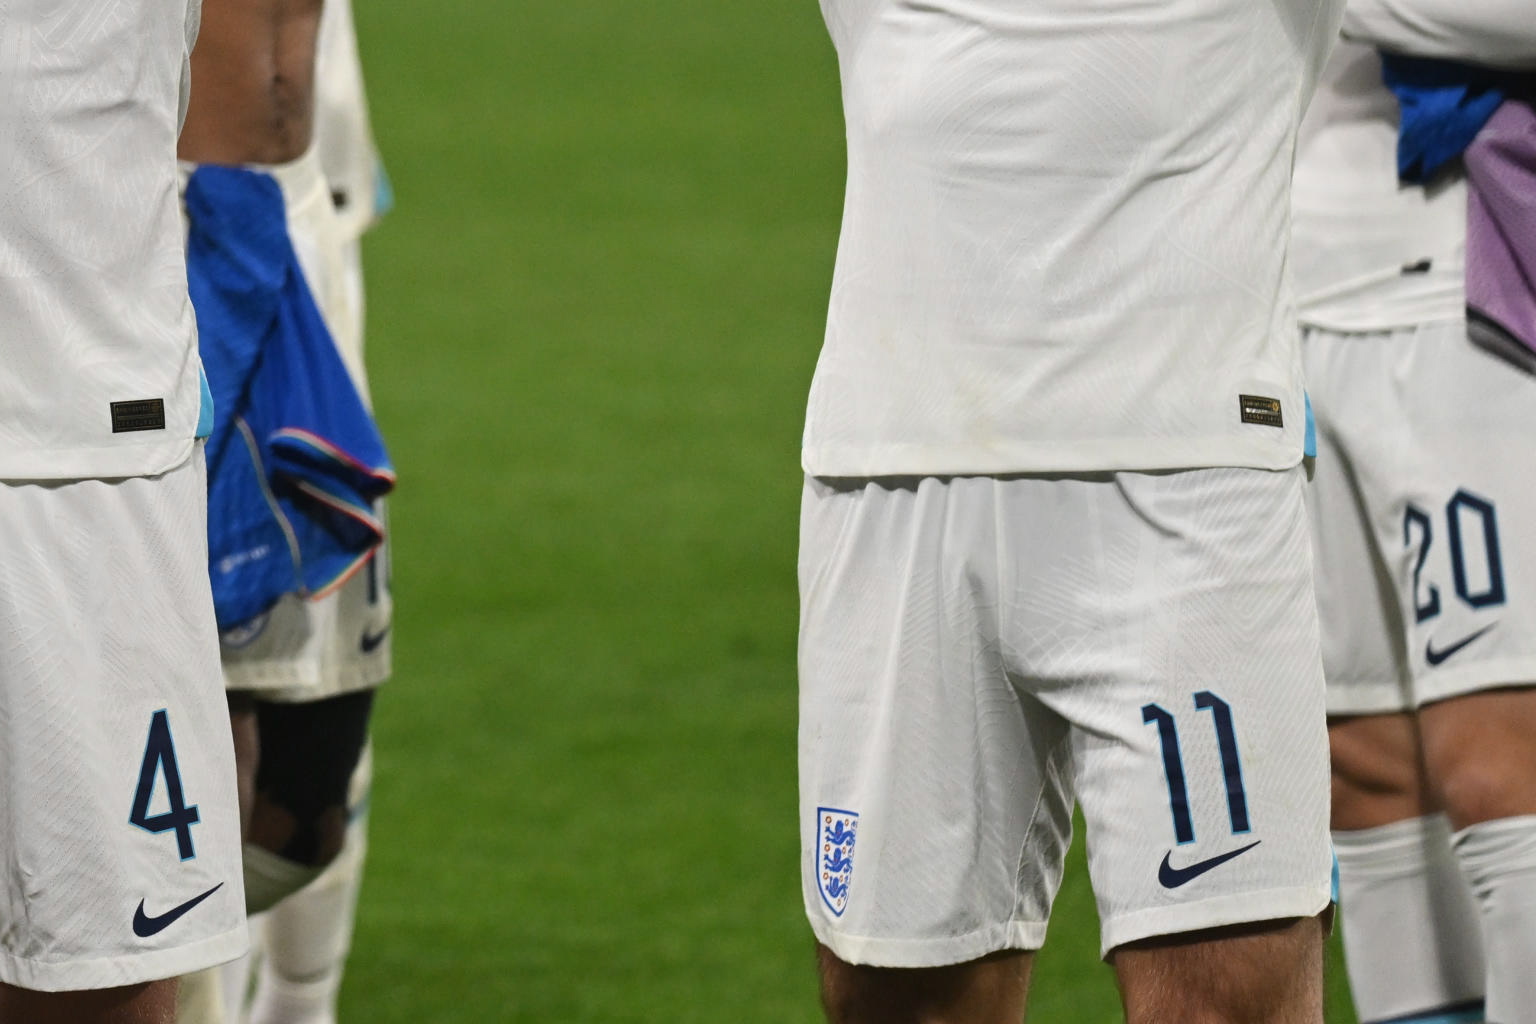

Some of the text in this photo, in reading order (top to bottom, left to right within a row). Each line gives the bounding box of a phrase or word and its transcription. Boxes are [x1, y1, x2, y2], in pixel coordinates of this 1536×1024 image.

[1403, 486, 1507, 624] 20
[127, 708, 202, 863] 4
[1140, 689, 1252, 847] 11
